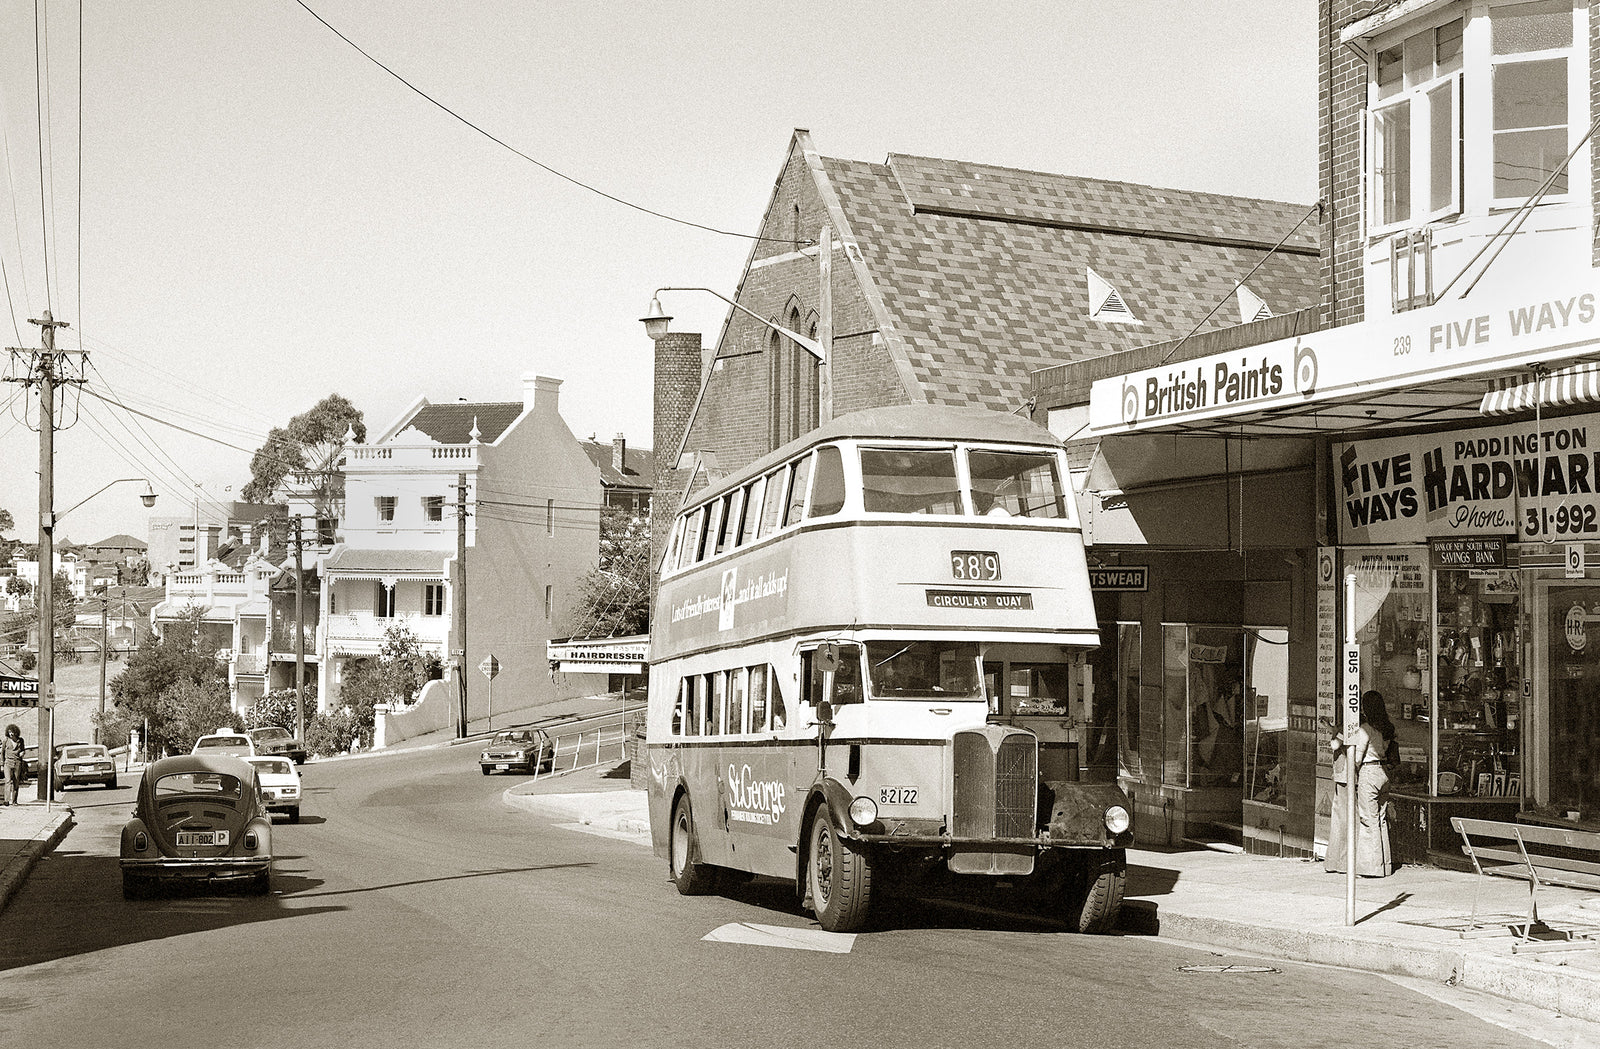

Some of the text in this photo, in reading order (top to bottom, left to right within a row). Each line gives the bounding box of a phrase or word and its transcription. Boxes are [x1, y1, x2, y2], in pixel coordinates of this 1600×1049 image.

[1393, 292, 1596, 356] 239 FIVE WAYS
[1145, 357, 1283, 417] British Paints
[1454, 426, 1587, 460] PADDINGTON
[1340, 444, 1413, 497] FIVE
[1346, 486, 1418, 528] WAYS
[1434, 541, 1500, 552] BANK OF NEW SOUTH WALES
[1441, 551, 1496, 563] SAVINGS BANK
[952, 555, 998, 581] 389
[934, 595, 1022, 607] CIRCULAR QUAY
[570, 652, 645, 660] HAIRDRESSER
[1348, 650, 1358, 674] BUS
[1348, 684, 1359, 713] STOP
[218, 833, 226, 843] P
